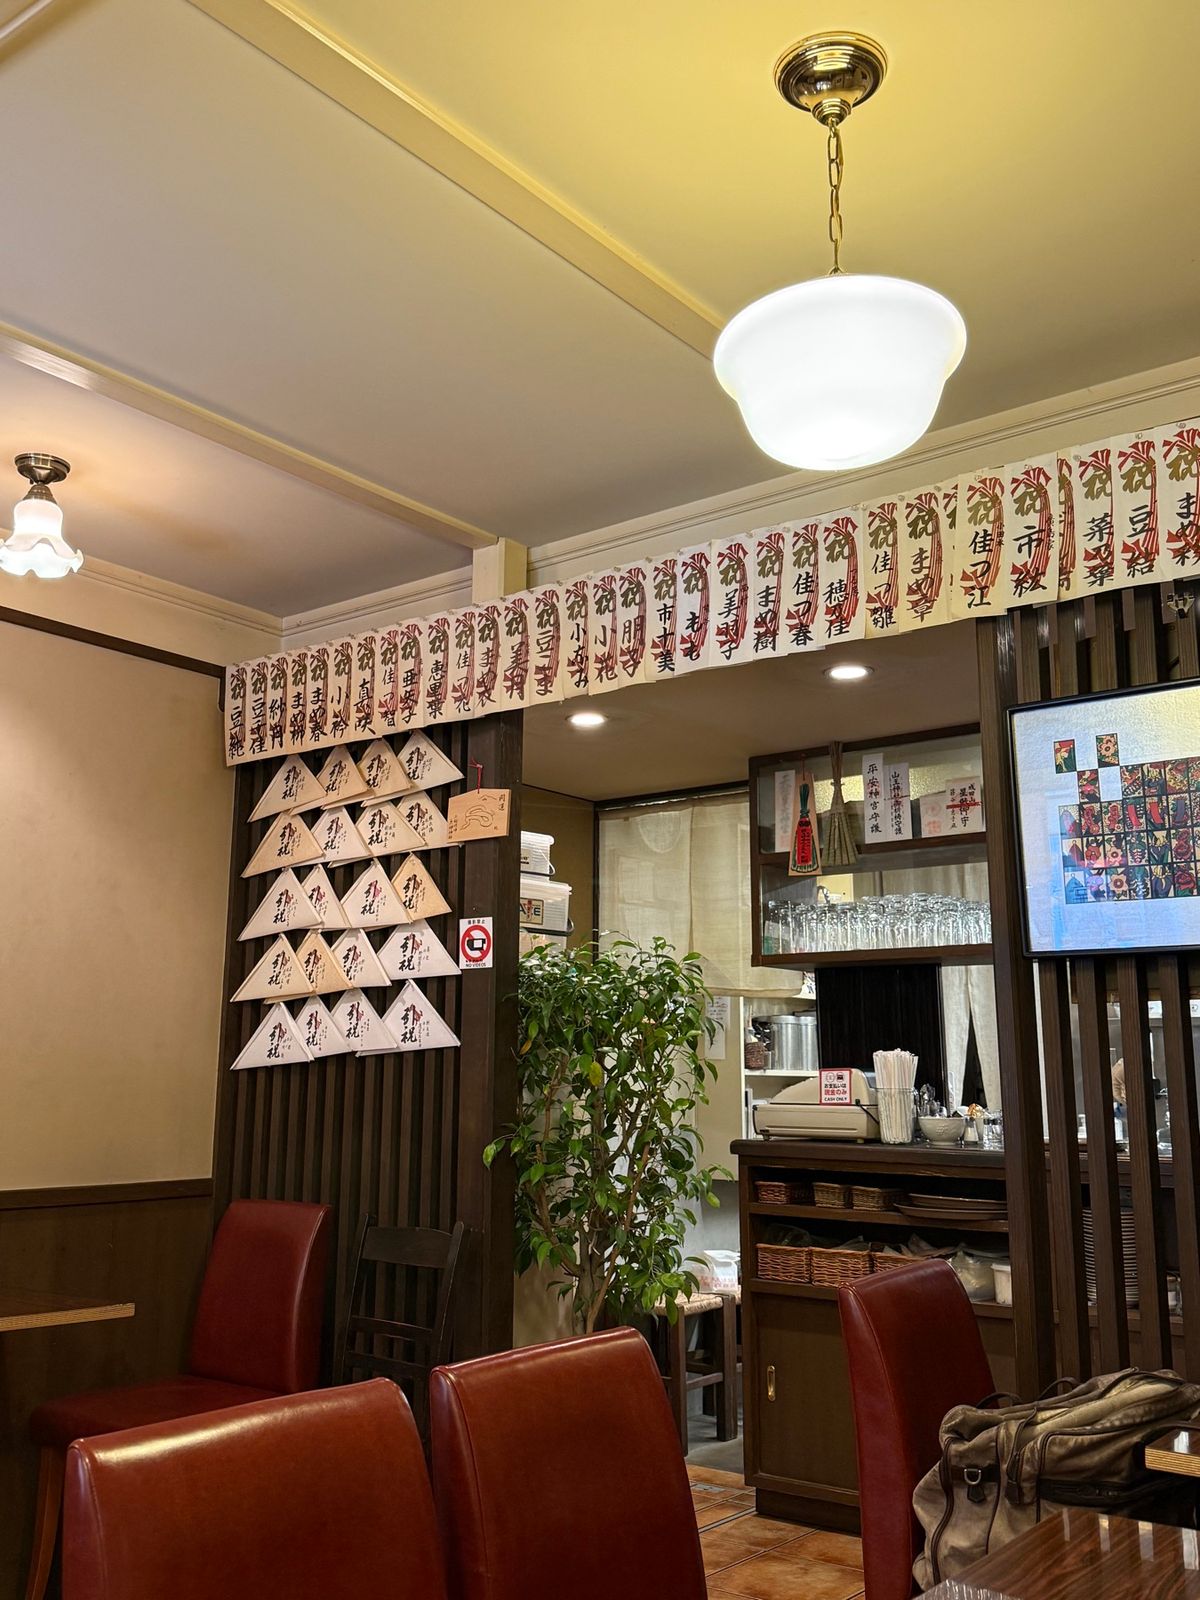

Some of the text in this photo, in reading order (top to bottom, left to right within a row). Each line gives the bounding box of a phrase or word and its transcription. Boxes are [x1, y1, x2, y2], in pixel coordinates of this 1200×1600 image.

[686, 612, 703, 660] もも
[791, 571, 814, 646] 佳つ春
[594, 625, 617, 683] 小花
